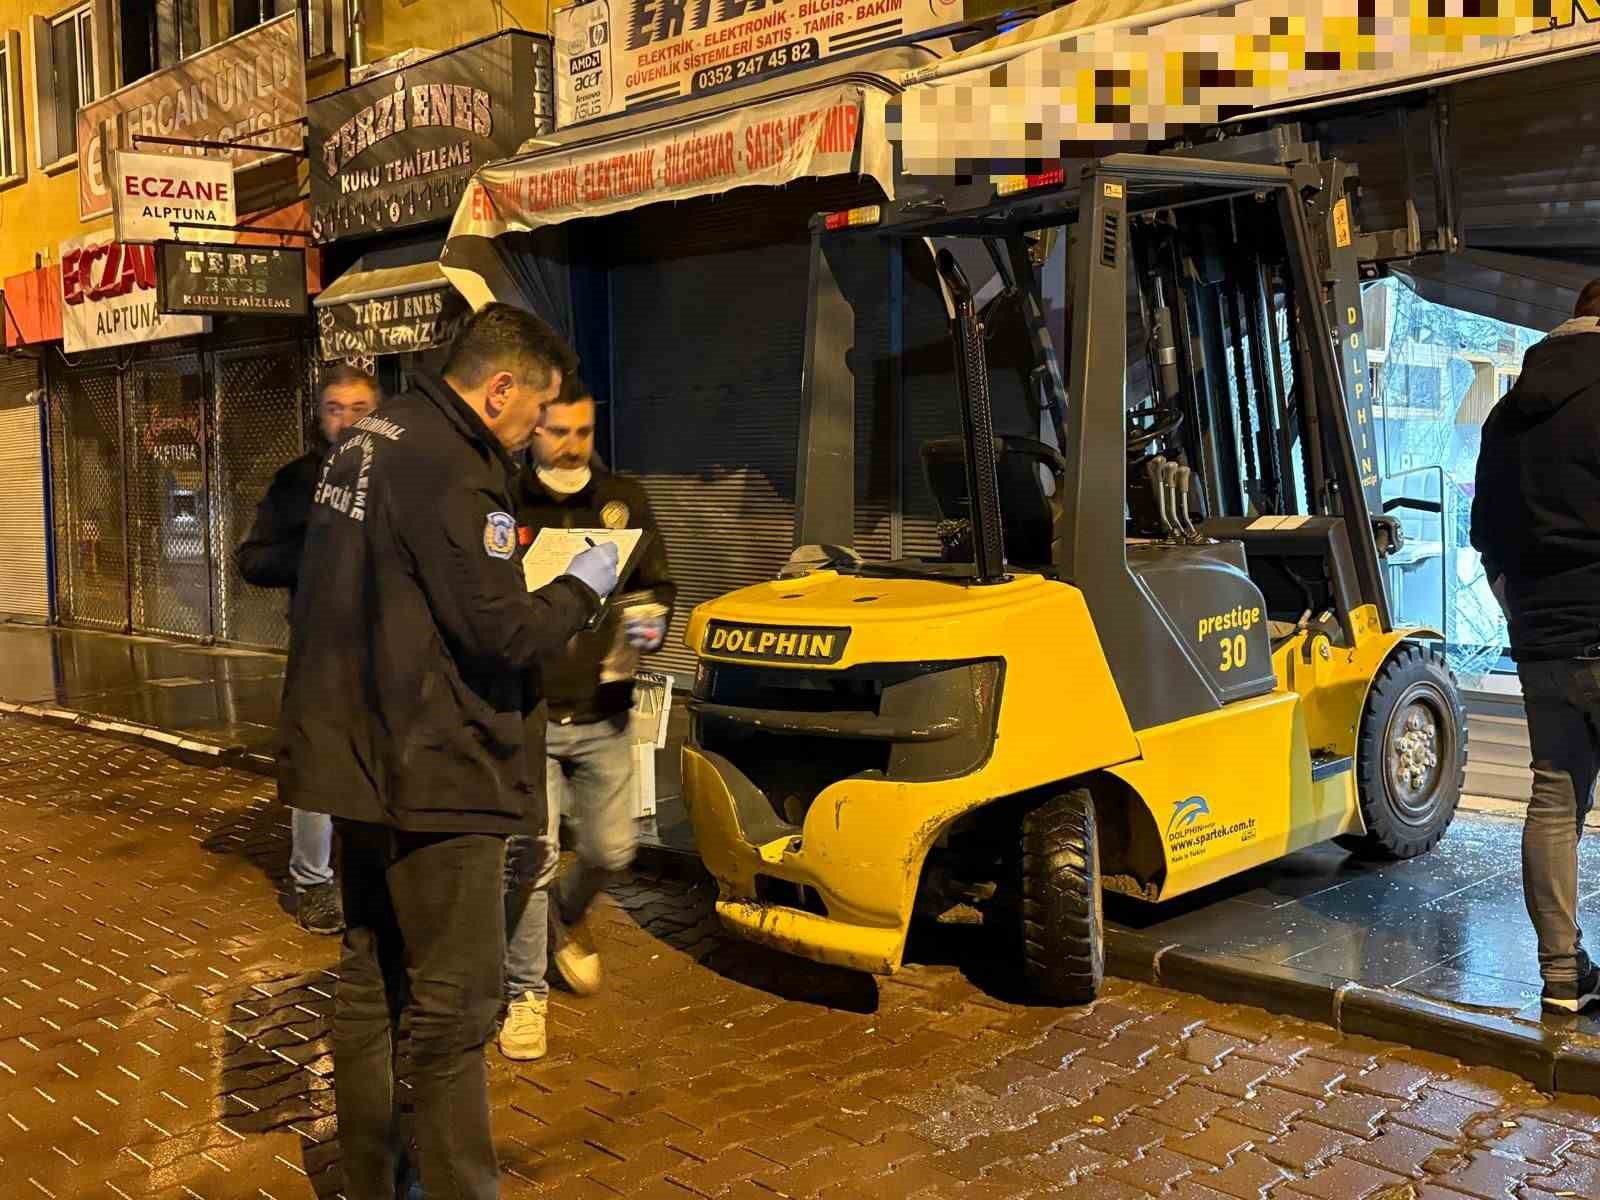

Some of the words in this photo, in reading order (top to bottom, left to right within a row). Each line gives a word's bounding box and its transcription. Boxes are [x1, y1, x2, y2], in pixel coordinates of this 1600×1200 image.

[625, 60, 680, 89] GÜVENLİK
[684, 39, 752, 71] SİSTEMLERİ
[755, 27, 792, 50] SATIŞ
[803, 10, 843, 35] TAMİR
[856, 0, 902, 21] BAKIM
[638, 39, 693, 67] ELEKTRİK
[704, 10, 786, 47] ELEKTRONİK
[699, 66, 732, 89] 0352
[737, 56, 763, 78] 247
[768, 49, 787, 67] 45
[791, 42, 811, 62] 82
[322, 76, 407, 177] TERZİ
[412, 84, 492, 137] ENES
[341, 167, 380, 195] KURU
[385, 140, 472, 181] TEMİZLEME
[125, 176, 229, 202] ECZANE
[142, 206, 217, 222] ALPTUNA
[183, 294, 219, 305] KURU
[224, 296, 291, 308] TEMİZLEME
[404, 293, 443, 318] ENES
[97, 303, 161, 336] ALPTUNA
[1346, 307, 1372, 474] DOLPHIN
[1199, 604, 1260, 641] prestige
[711, 628, 834, 657] DOLPHIN
[1219, 635, 1247, 672] 30
[1168, 825, 1202, 842] DOLPHIN
[1171, 818, 1255, 853] www.spartek.com.tr
